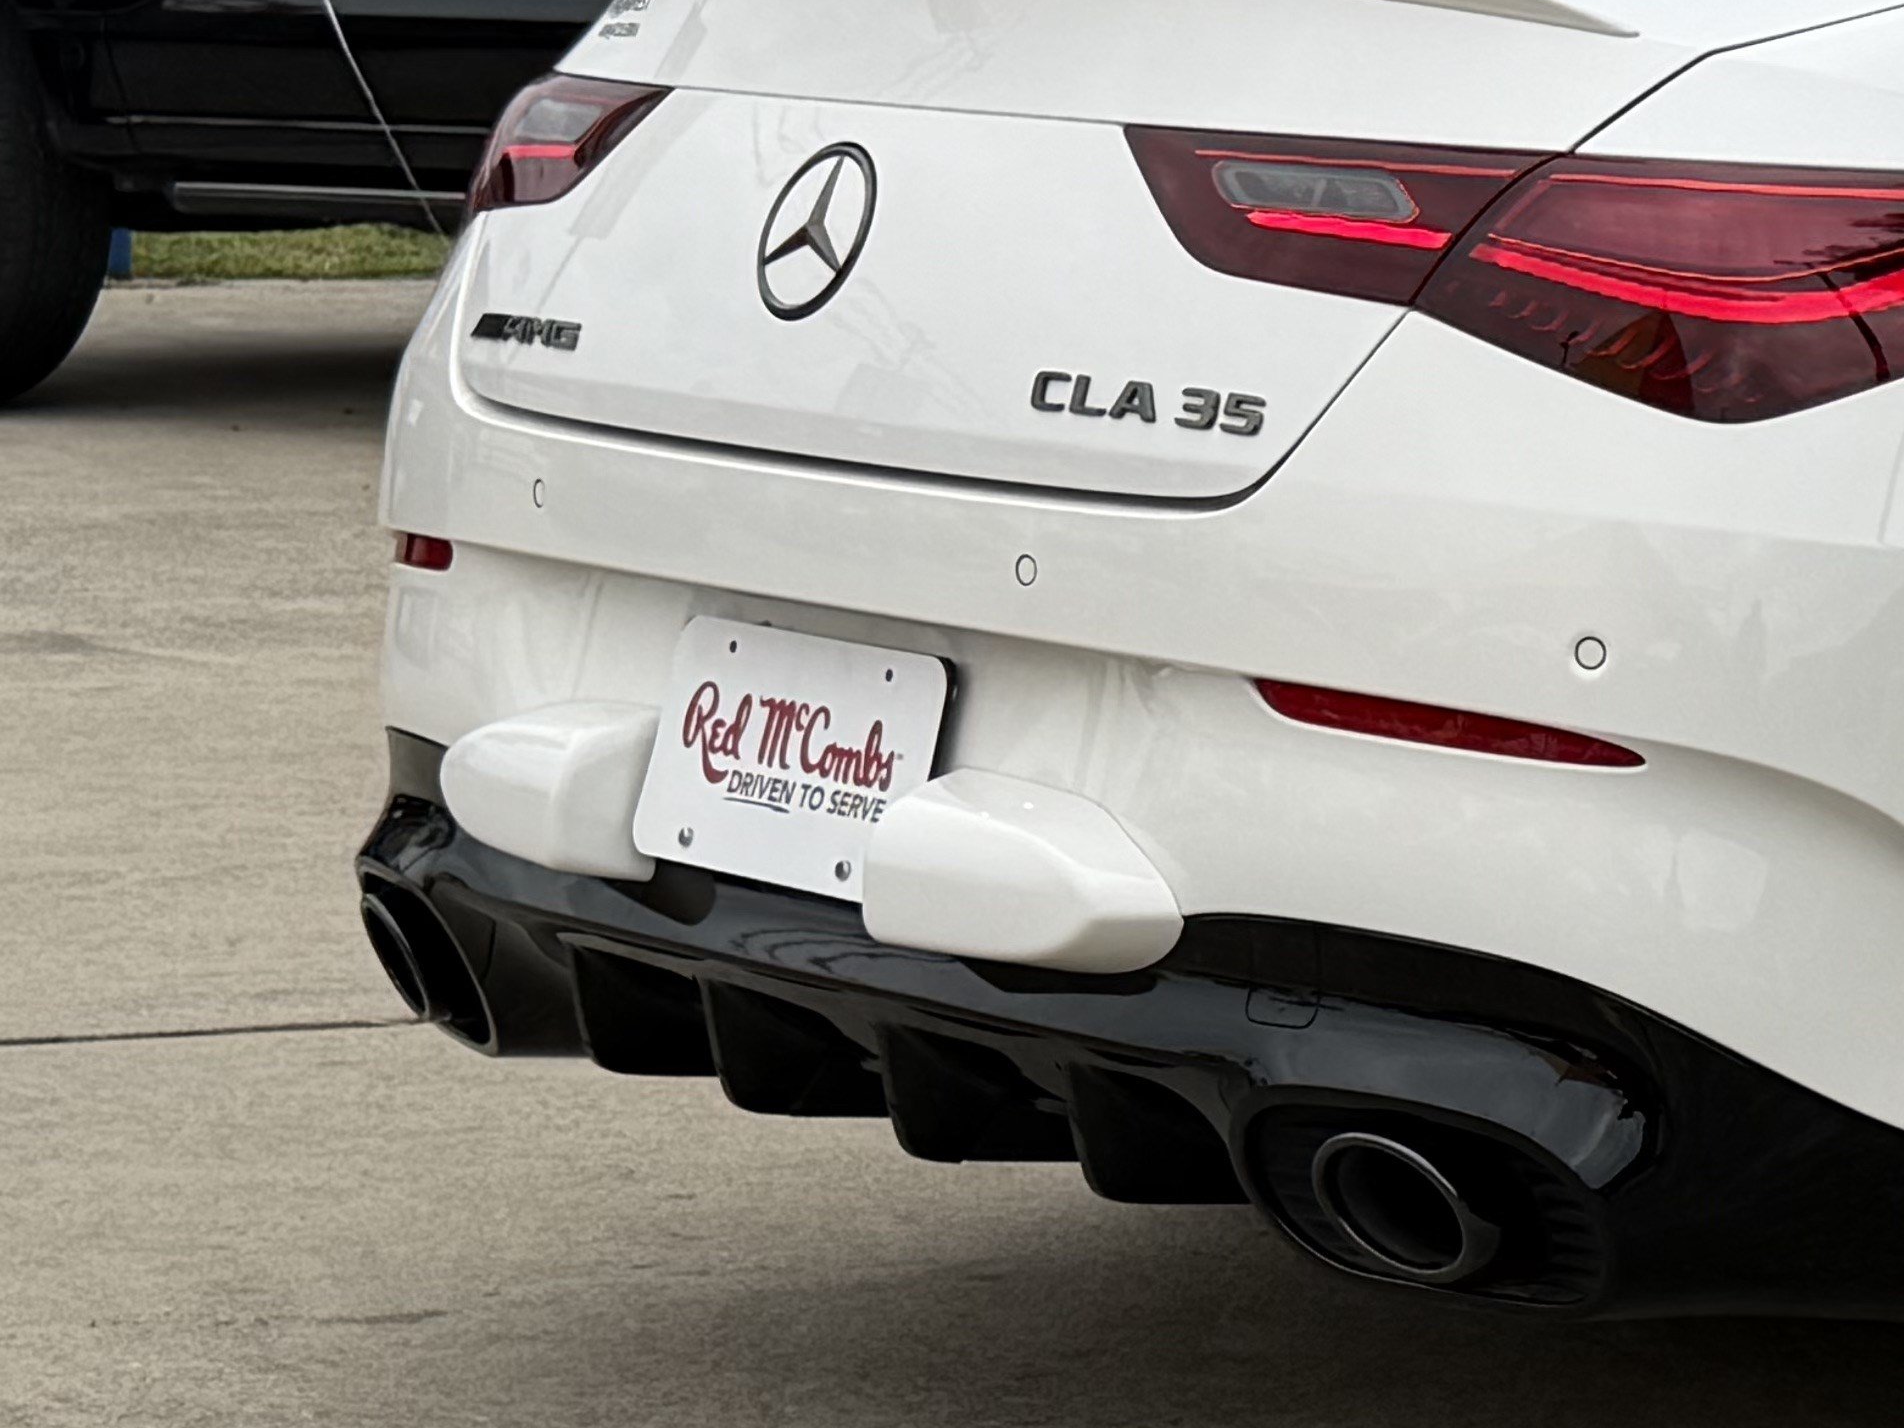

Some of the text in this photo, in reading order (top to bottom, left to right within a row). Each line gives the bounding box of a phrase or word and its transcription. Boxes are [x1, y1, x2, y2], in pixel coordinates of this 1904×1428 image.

[496, 314, 582, 351] AMG
[1030, 370, 1267, 437] CLA 35
[682, 681, 896, 792] Red McCombs
[726, 769, 888, 824] DRIVEN TO SERVE
